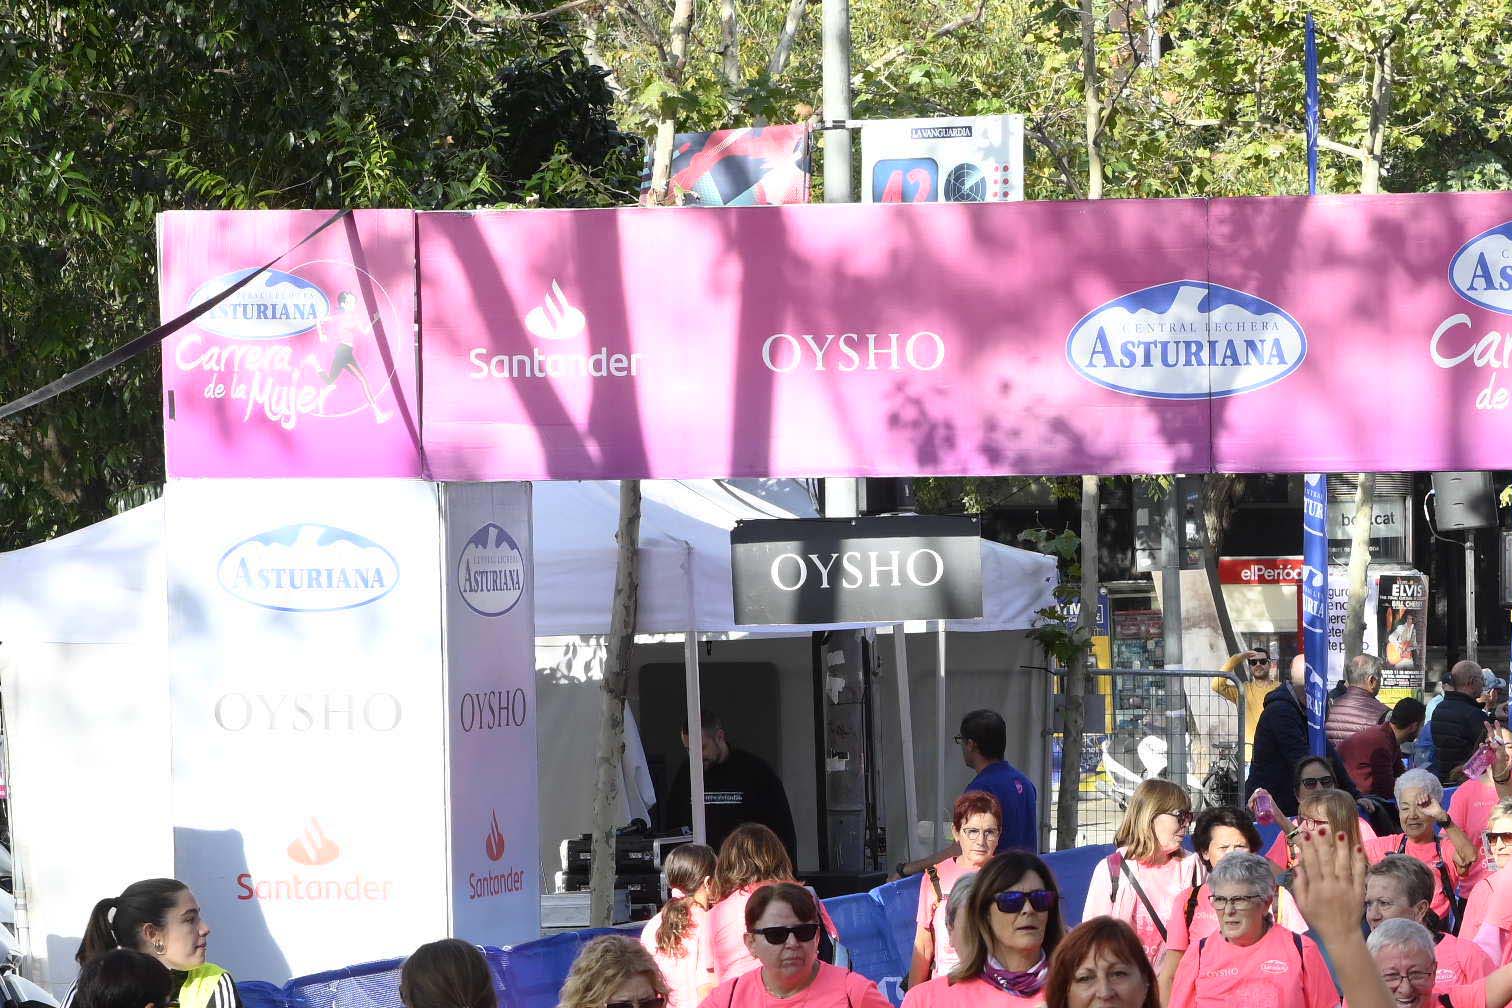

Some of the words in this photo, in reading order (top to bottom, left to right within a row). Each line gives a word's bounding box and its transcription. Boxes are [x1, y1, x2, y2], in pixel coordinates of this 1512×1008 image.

[921, 127, 971, 138] VANGUARDIA
[208, 302, 318, 321] STURIANA
[1122, 320, 1197, 333] CENTRAL
[1204, 319, 1281, 333] LECHERA
[175, 336, 293, 372] Carrera
[468, 347, 642, 379] Santander
[761, 330, 945, 373] OYSHO
[1085, 326, 1289, 370] ASTURIANA
[204, 374, 226, 400] de
[231, 375, 246, 400] la
[244, 366, 337, 430] Mujer
[1475, 371, 1508, 412] de
[234, 556, 386, 590] ASTURIANA
[462, 559, 521, 595] ASTURIANA
[770, 548, 945, 591] OYSHO
[1392, 584, 1423, 597] ELVIS
[214, 690, 402, 734] OYSHO
[460, 687, 527, 732] OYSHO
[236, 873, 393, 902] Santander
[468, 868, 525, 901] Santander
